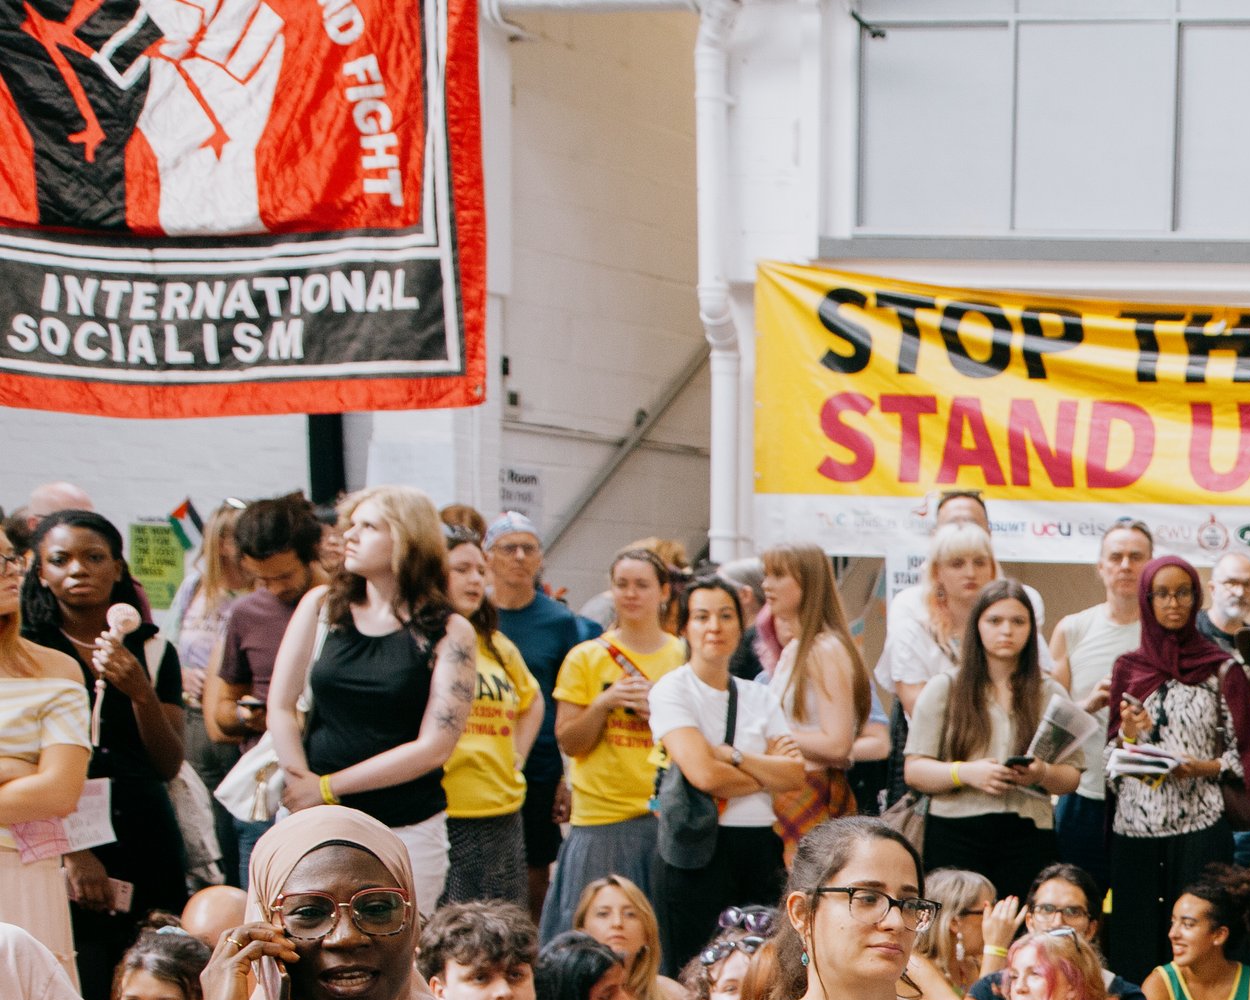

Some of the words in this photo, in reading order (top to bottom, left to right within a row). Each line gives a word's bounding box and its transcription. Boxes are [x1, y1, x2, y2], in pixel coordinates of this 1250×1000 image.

[342, 53, 405, 208] FIGHT
[6, 313, 304, 365] SOCIALISM
[40, 268, 421, 322] INTERNATIONAL
[817, 287, 1085, 380] STOP
[817, 391, 1156, 489] STAND
